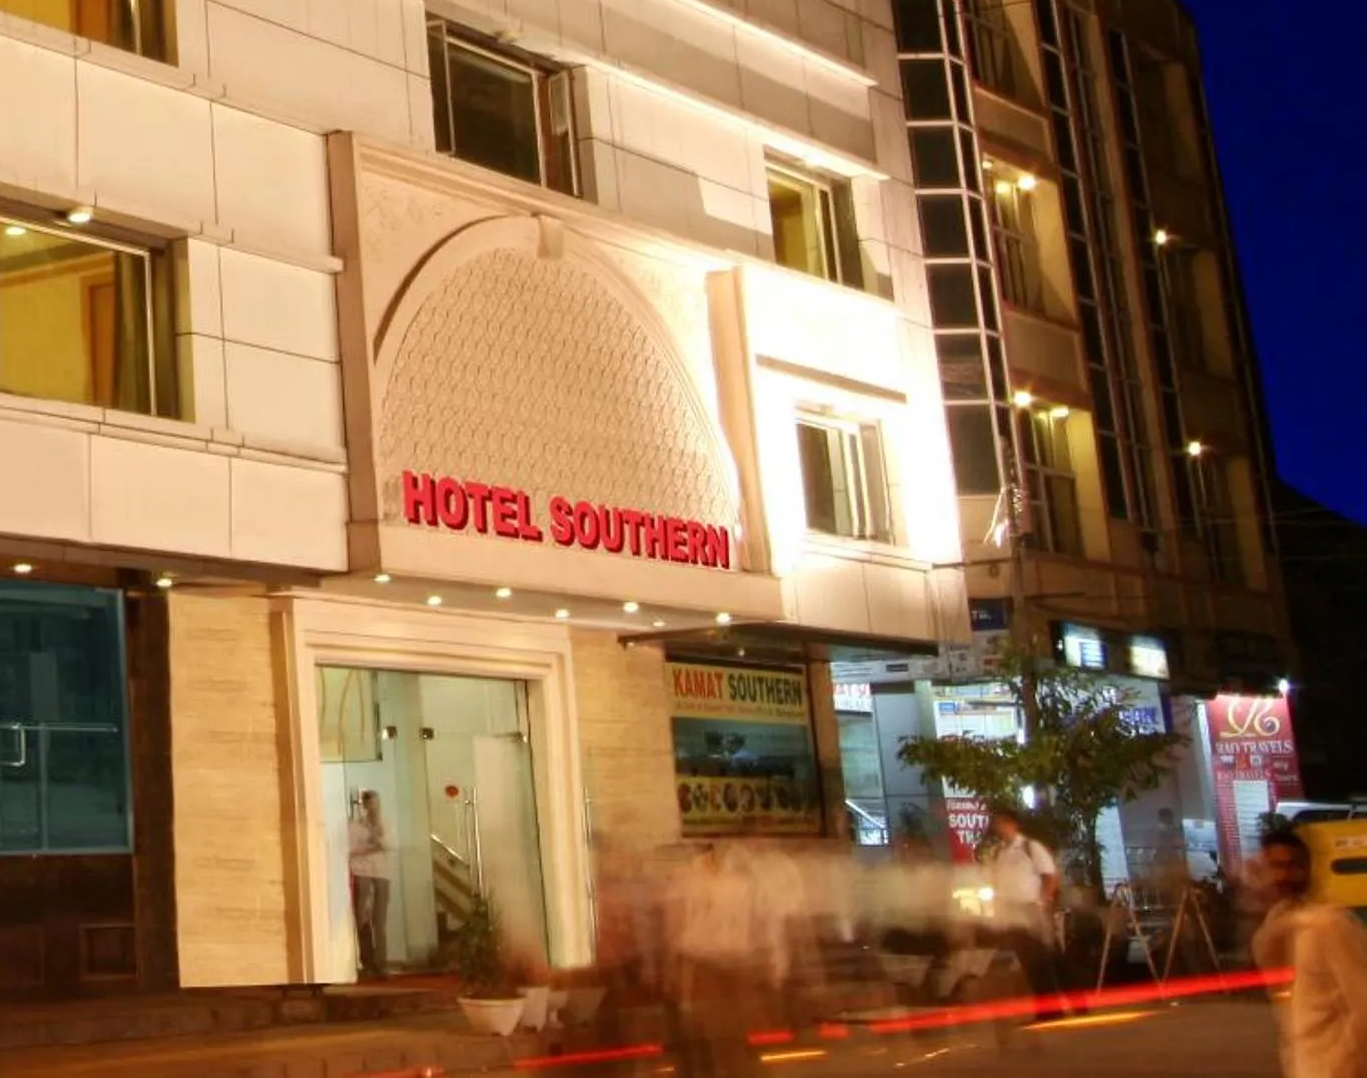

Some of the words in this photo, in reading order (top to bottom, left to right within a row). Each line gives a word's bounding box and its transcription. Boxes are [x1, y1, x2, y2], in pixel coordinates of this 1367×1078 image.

[402, 470, 543, 541] HOTEL
[549, 496, 730, 569] SOUTHERN
[673, 667, 724, 700] KAMAT
[728, 672, 803, 707] SOUTHERN
[948, 812, 990, 830] SOUT
